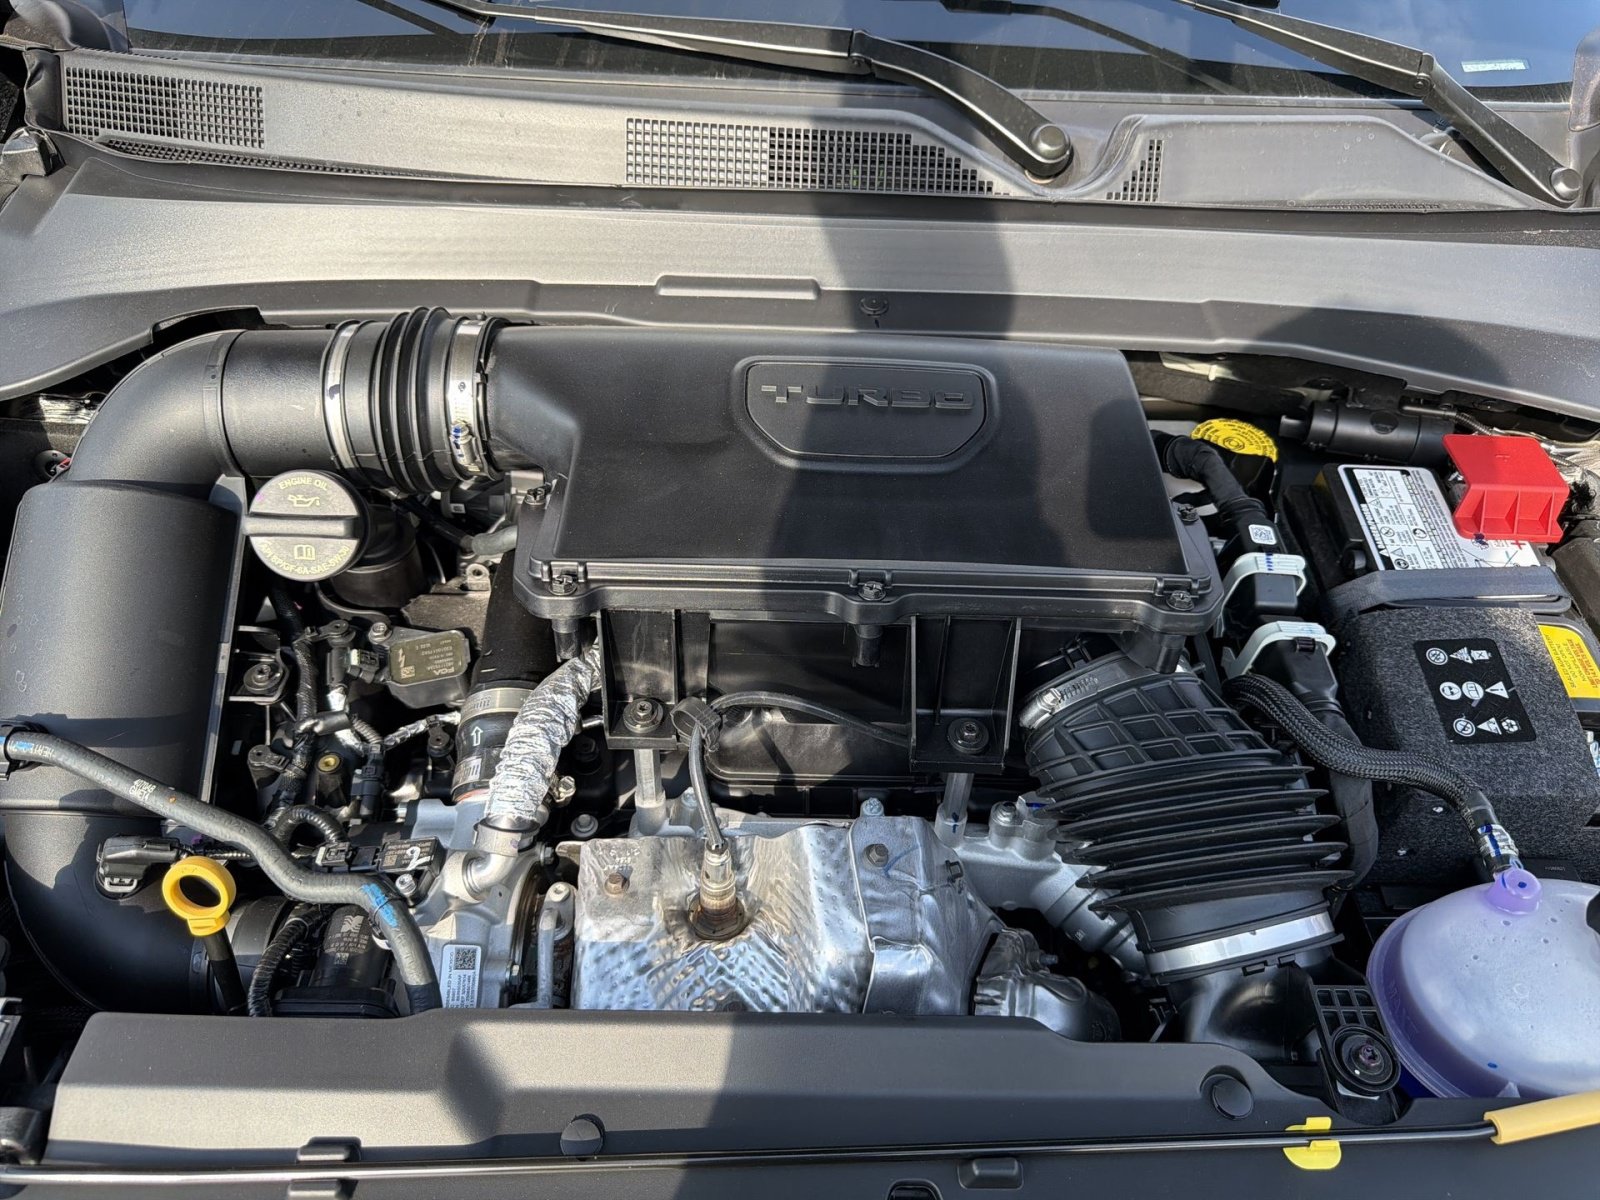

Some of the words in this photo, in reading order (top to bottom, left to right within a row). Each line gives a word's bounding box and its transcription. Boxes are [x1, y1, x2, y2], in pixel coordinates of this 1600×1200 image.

[761, 384, 975, 409] TURBO
[278, 475, 313, 490] ENGINE
[313, 479, 329, 491] OIL
